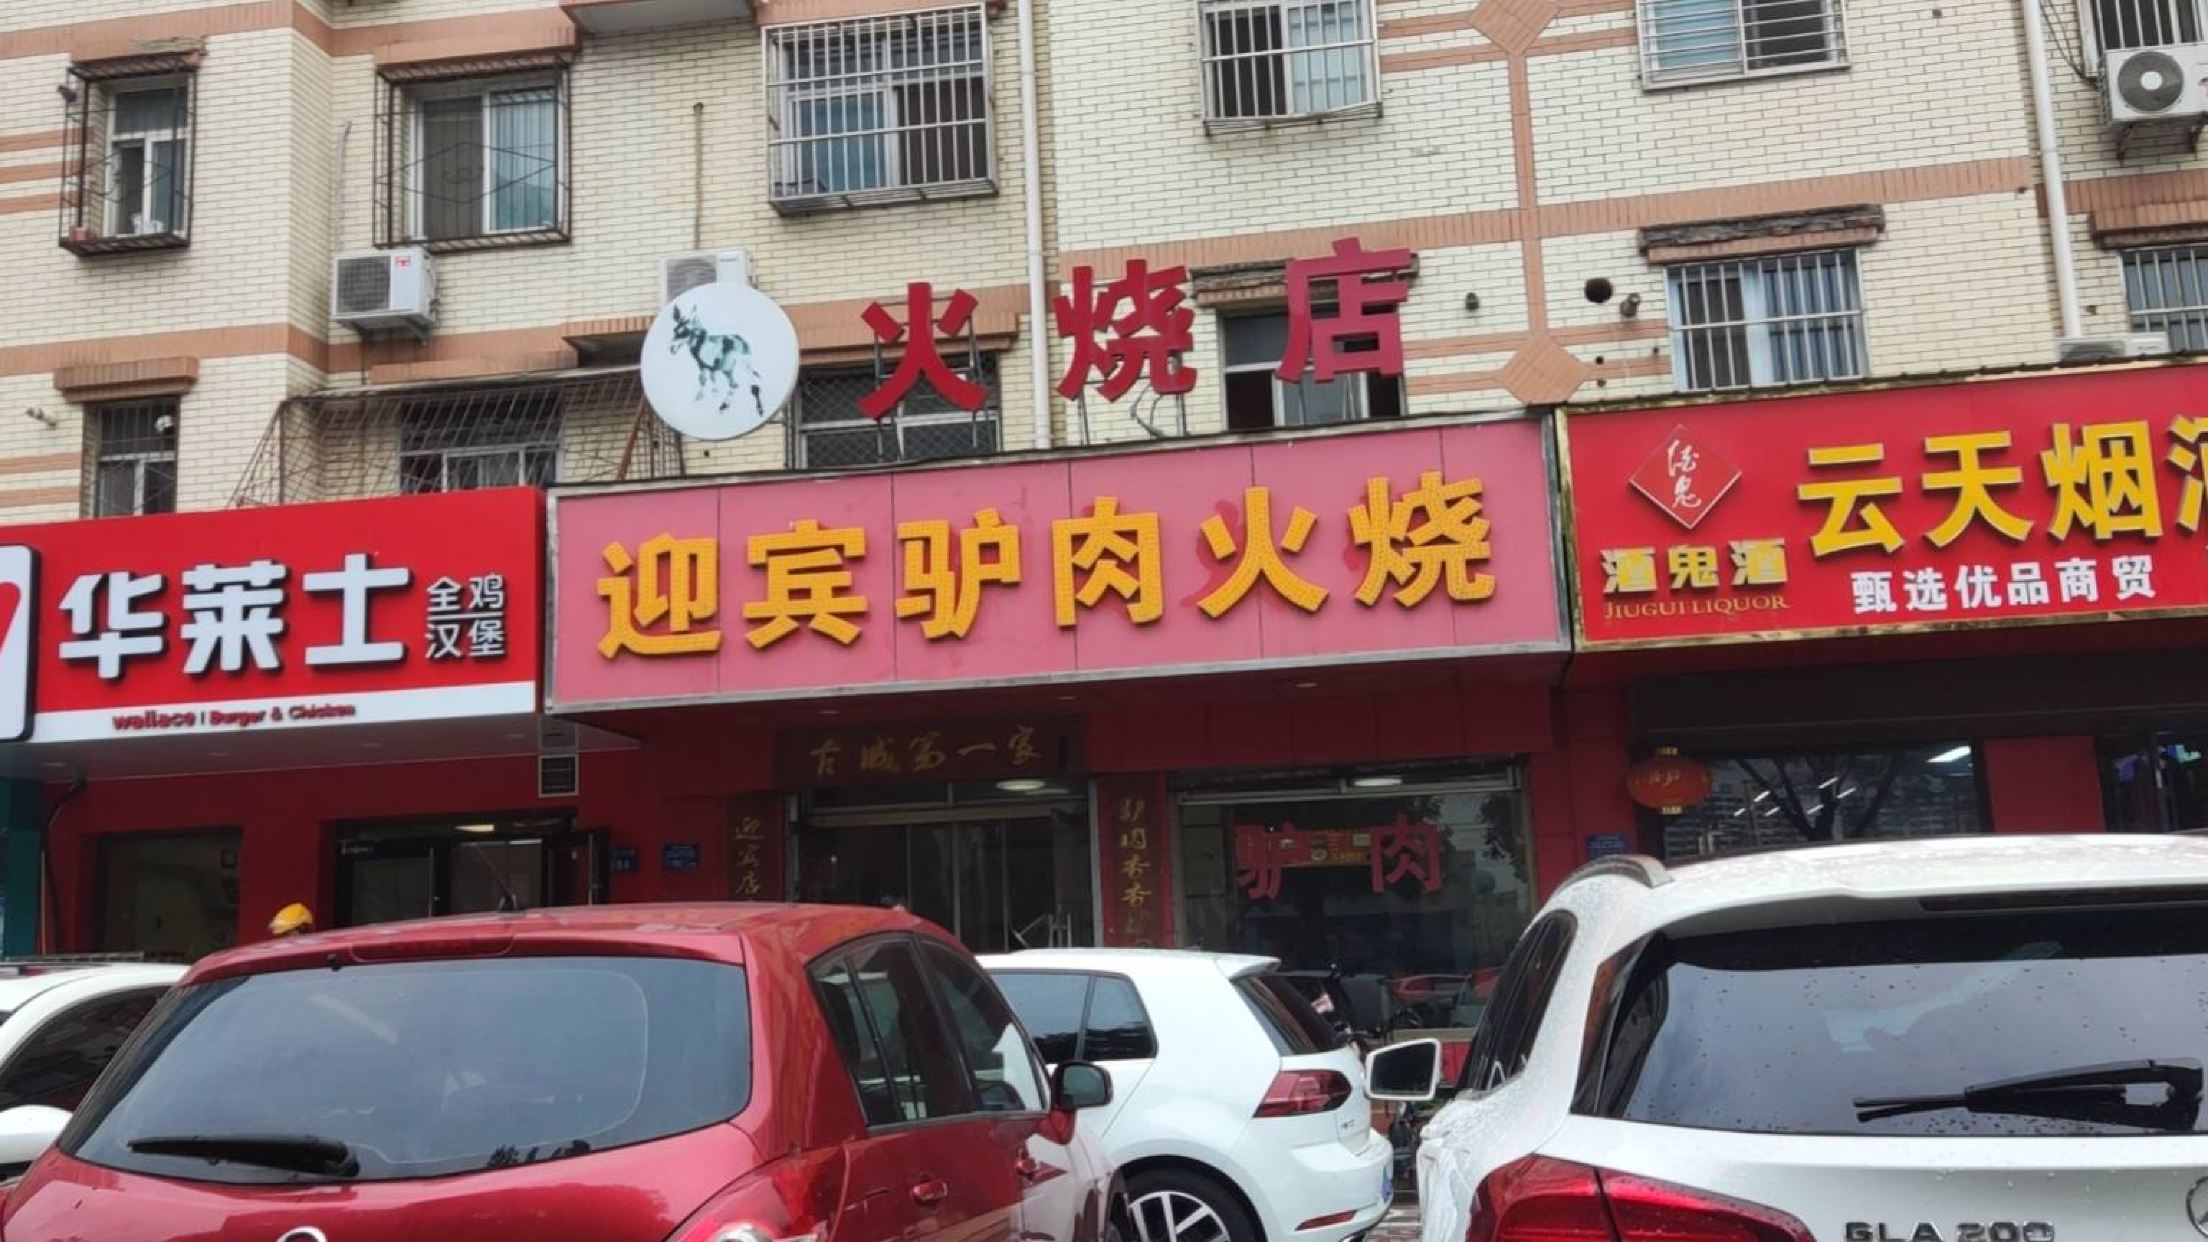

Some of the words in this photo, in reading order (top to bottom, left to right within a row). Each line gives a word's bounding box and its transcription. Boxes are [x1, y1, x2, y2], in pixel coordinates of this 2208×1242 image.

[859, 237, 1414, 421] 火烧店
[426, 572, 505, 612] 全鸡
[598, 471, 1496, 659] 迎宾驴肉火烧
[1600, 538, 1788, 594] 酒鬼酒
[1850, 554, 2155, 614] 甄选优品商贸
[58, 552, 409, 679] 华莱士
[1603, 600, 1686, 620] JIUGUI
[1692, 593, 1790, 616] LIQUOR
[424, 619, 506, 659] 汉堡
[1845, 1221, 1944, 1242] GLA
